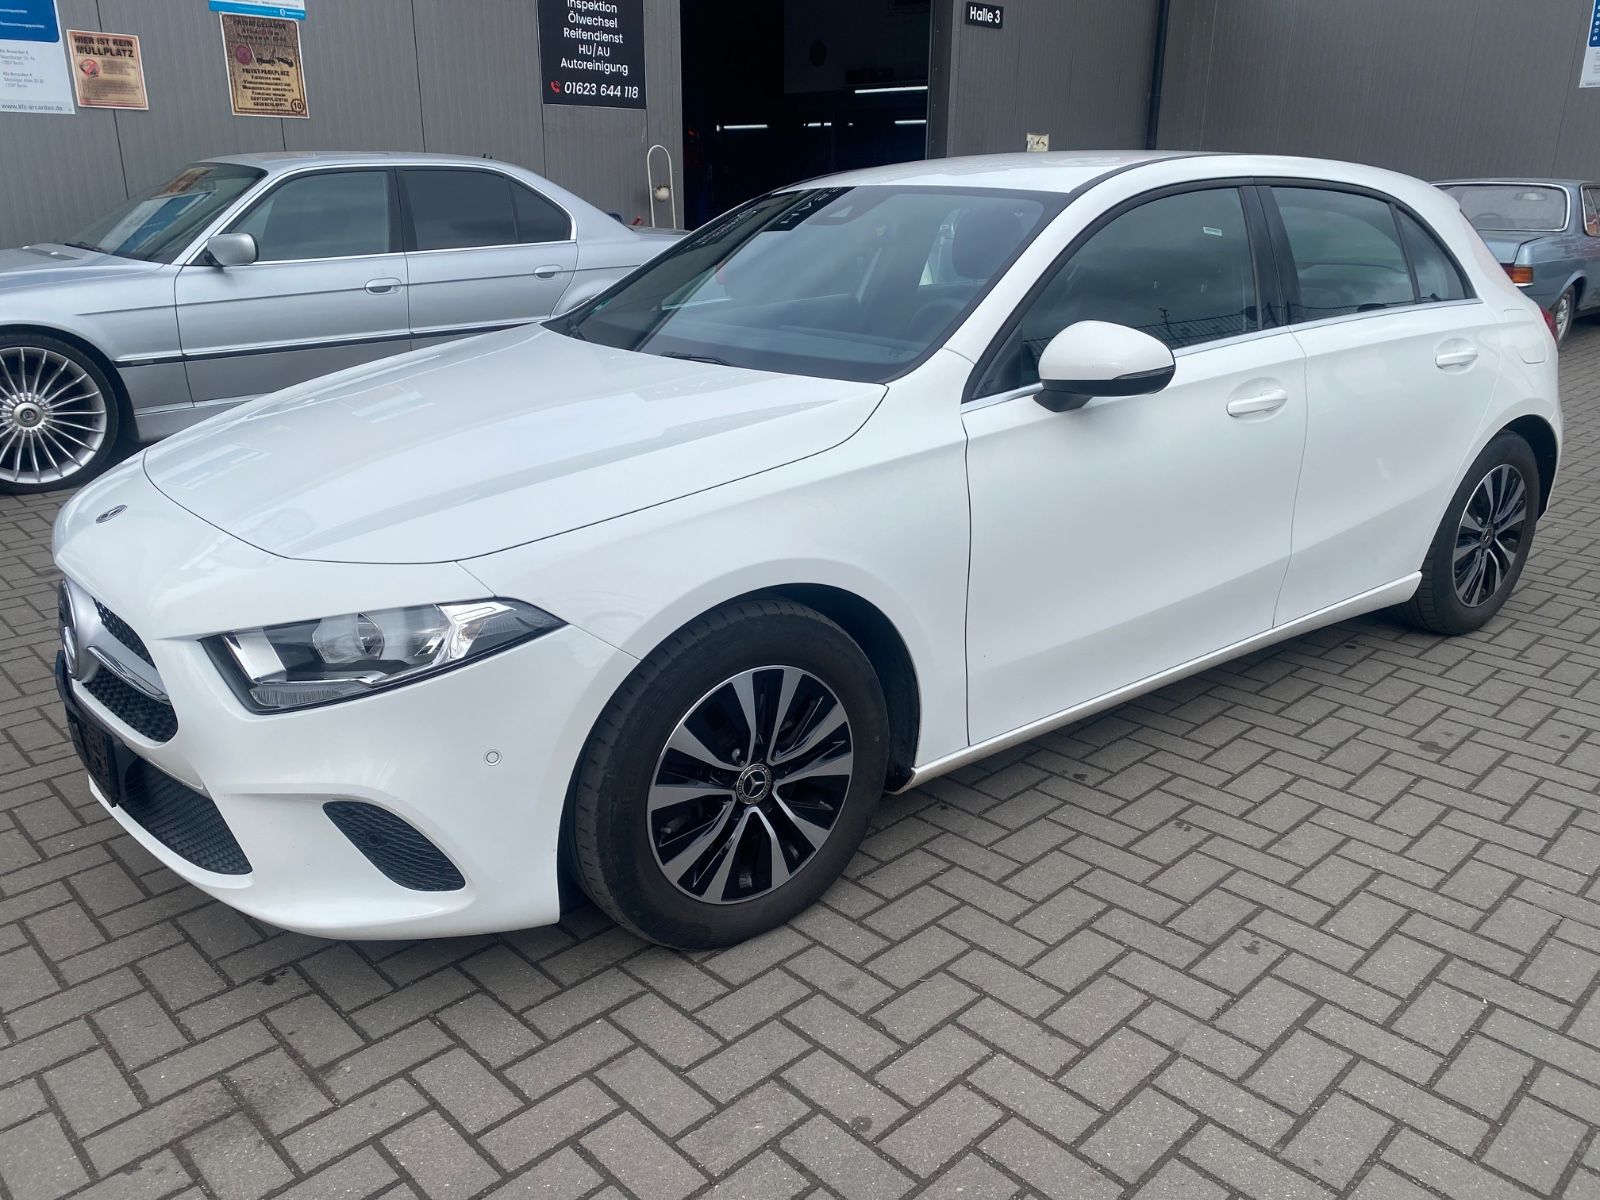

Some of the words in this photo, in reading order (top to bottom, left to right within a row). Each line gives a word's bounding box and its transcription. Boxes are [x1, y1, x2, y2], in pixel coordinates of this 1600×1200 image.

[567, 0, 617, 13] Inspektion
[568, 10, 618, 28] Ölwechsel
[970, 6, 993, 22] Halle
[995, 10, 1001, 24] 3
[74, 35, 94, 44] HIER
[96, 37, 109, 45] IST
[112, 38, 133, 47] KEIN
[563, 27, 623, 43] Reifendienst
[578, 43, 610, 57] HU/AU
[560, 58, 628, 76] Autoreinigung
[564, 81, 597, 96] 01623
[600, 84, 621, 97] 644
[624, 86, 639, 98] 118
[293, 102, 302, 110] 10
